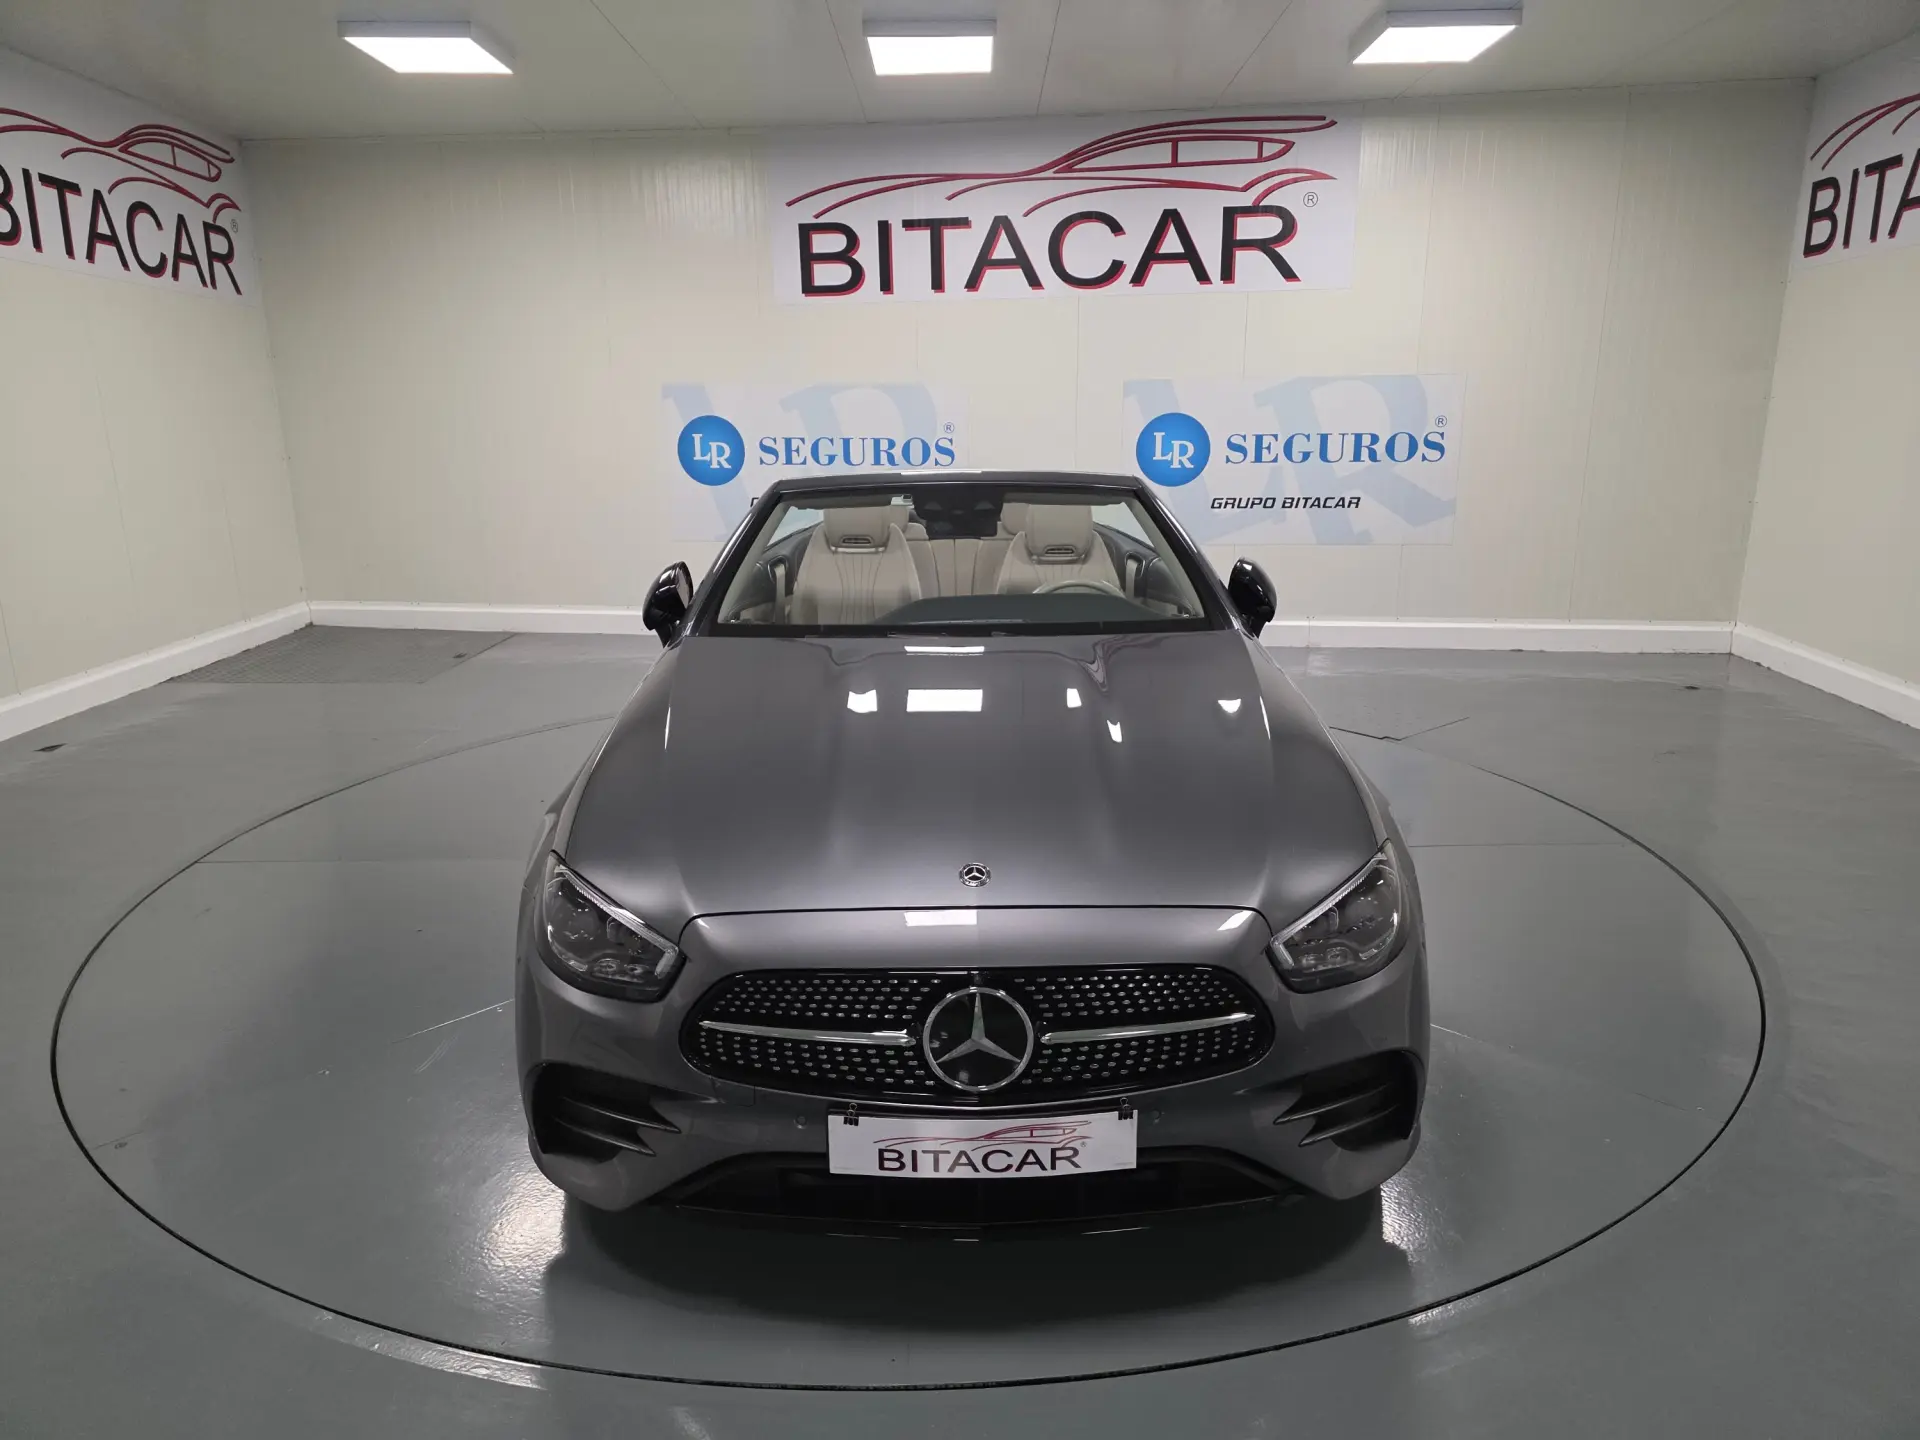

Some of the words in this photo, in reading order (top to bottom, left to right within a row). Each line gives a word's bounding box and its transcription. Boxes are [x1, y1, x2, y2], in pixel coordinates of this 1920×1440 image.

[798, 205, 1302, 297] BITACAR
[692, 433, 731, 469] LR
[759, 437, 955, 466] SEGUROS
[1153, 432, 1195, 469] LR
[1225, 431, 1446, 464] SEGUROS
[1210, 497, 1276, 510] GRUPO
[1281, 496, 1361, 509] BITACAR
[878, 1147, 1082, 1173] BITACAR
